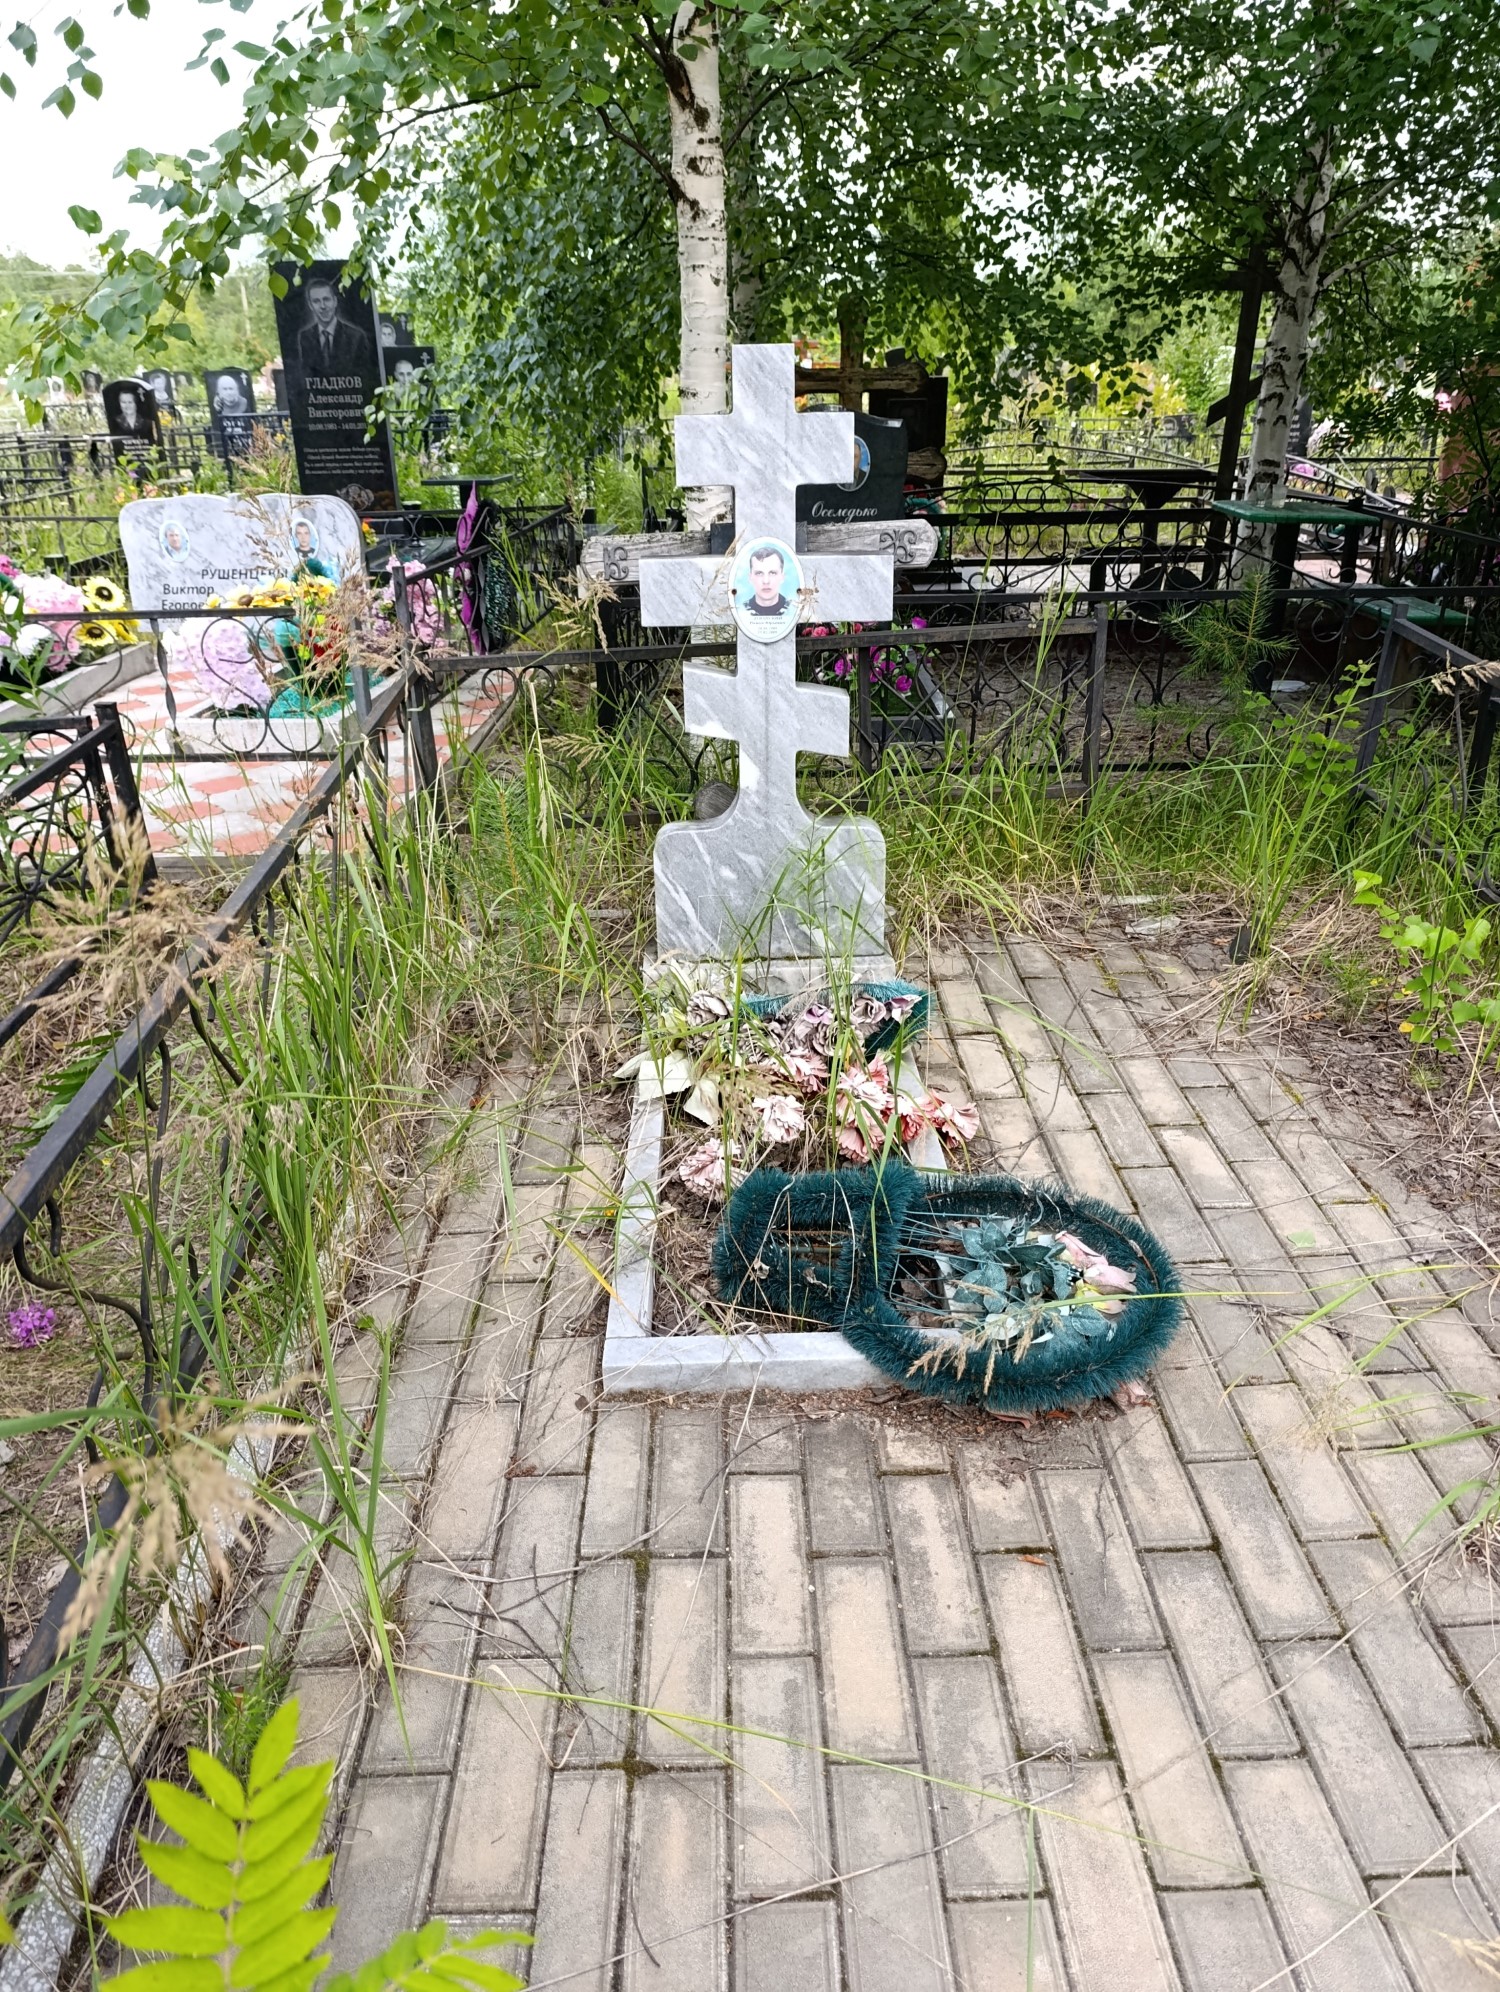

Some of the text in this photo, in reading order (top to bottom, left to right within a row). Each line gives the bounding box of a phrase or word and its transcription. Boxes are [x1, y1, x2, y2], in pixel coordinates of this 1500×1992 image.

[305, 376, 362, 390] ГЛАДКОВ
[308, 392, 363, 404] Александр
[811, 500, 878, 523] Оселедько
[163, 583, 215, 597] Виктор
